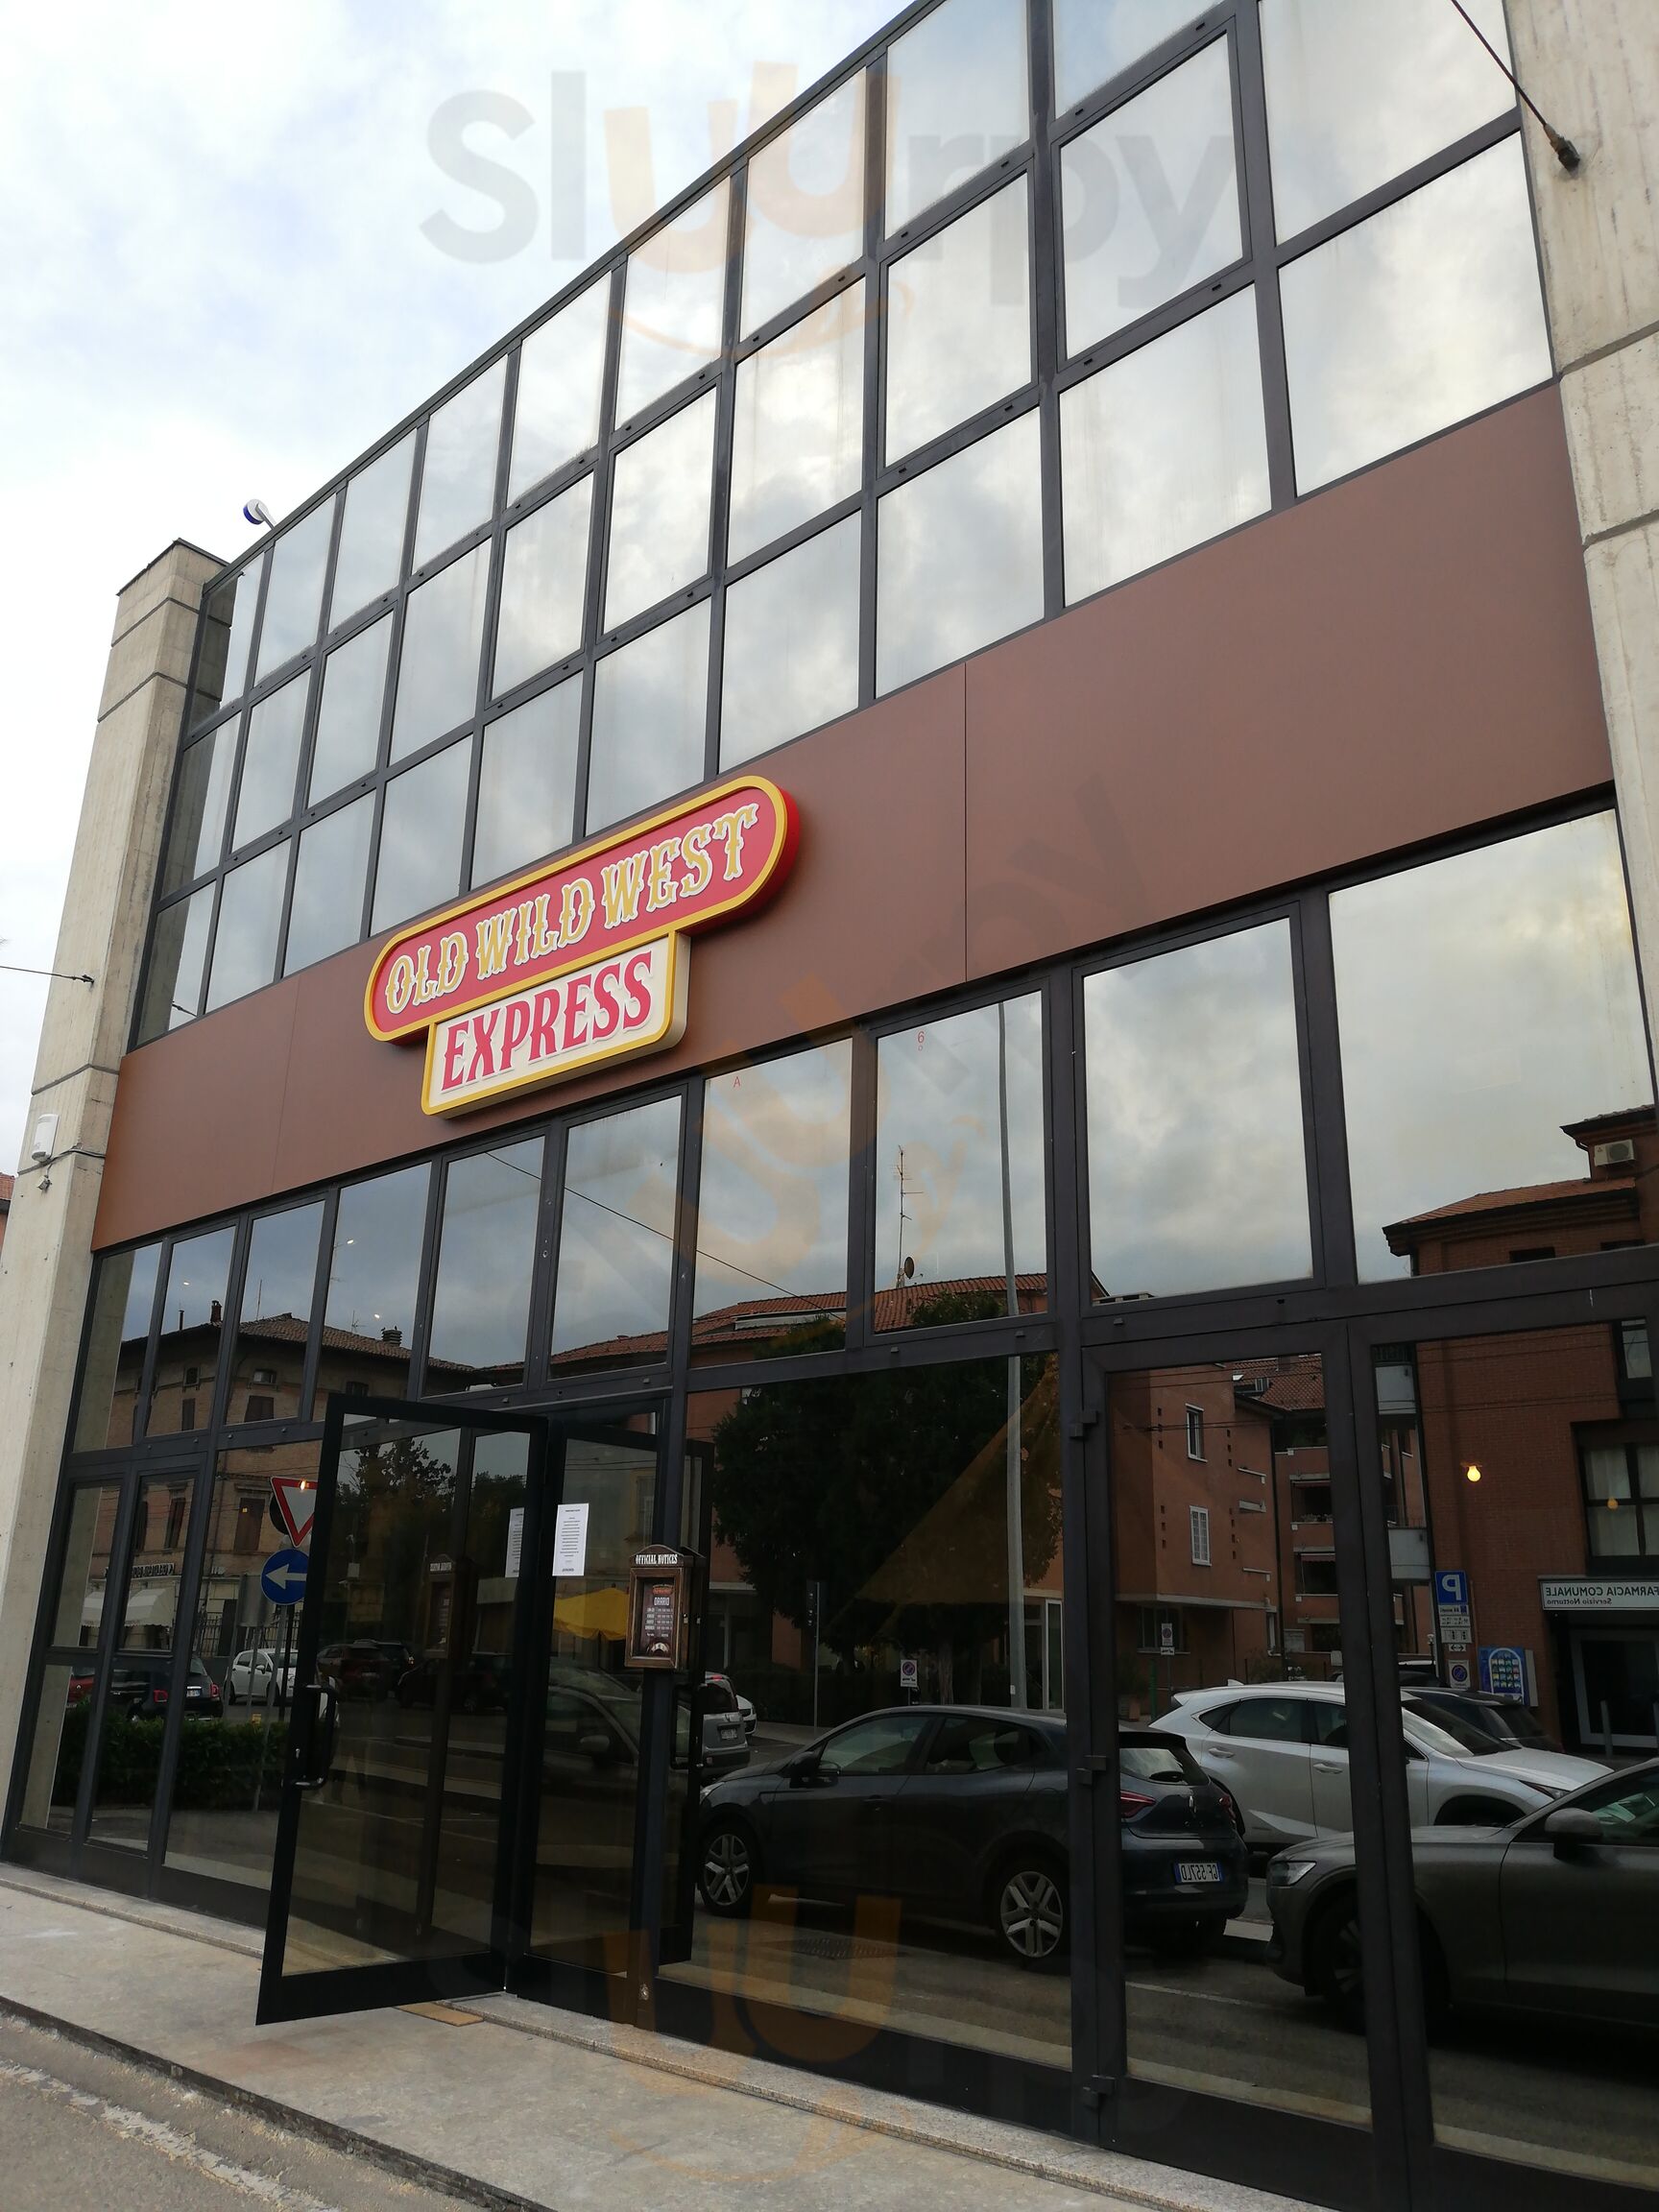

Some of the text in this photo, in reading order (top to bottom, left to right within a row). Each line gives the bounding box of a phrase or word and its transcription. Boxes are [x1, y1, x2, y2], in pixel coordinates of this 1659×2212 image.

[385, 803, 759, 1015] OLD WILD WEST
[440, 950, 655, 1092] EXPRESS
